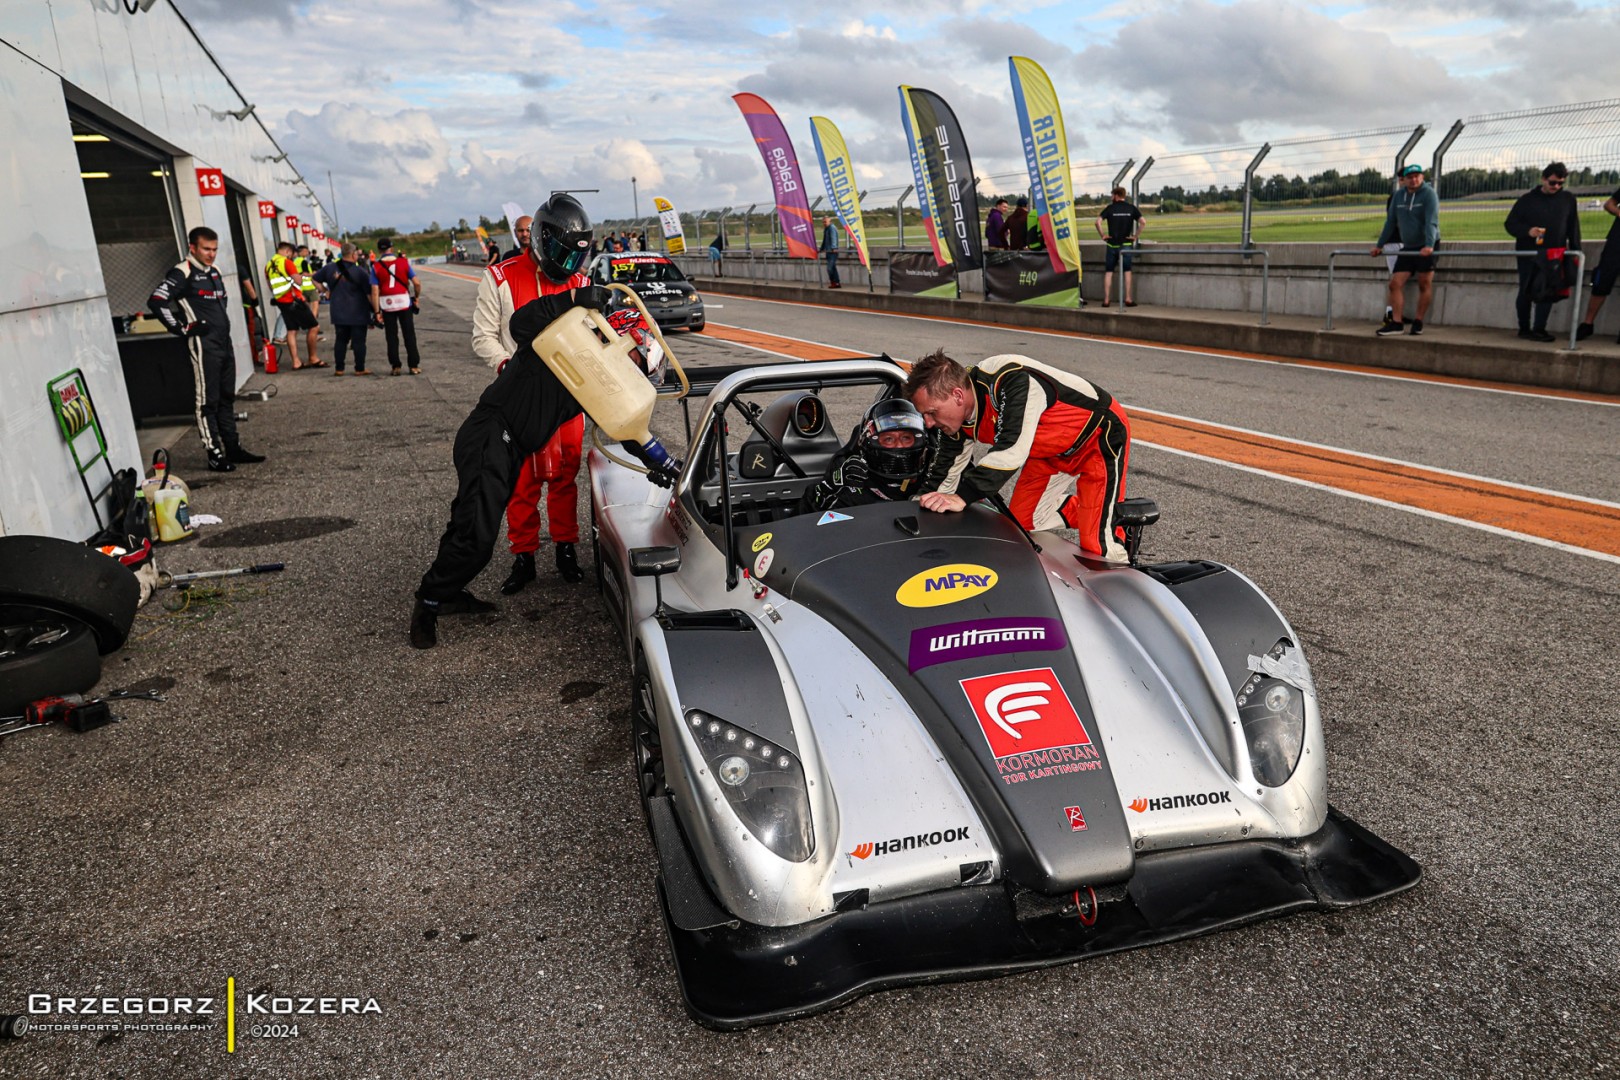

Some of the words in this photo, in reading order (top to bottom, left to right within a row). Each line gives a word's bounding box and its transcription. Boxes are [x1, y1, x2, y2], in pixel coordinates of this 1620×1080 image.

[200, 174, 221, 189] 13
[260, 204, 274, 214] 12
[612, 262, 636, 272] 157
[388, 264, 395, 288] 1
[1019, 271, 1038, 286] #49
[751, 453, 767, 470] R
[930, 627, 1046, 653] Wittmann
[995, 744, 1101, 774] KORMORAN
[1002, 771, 1028, 785] TOR
[1028, 760, 1102, 780] KARTINGOWY
